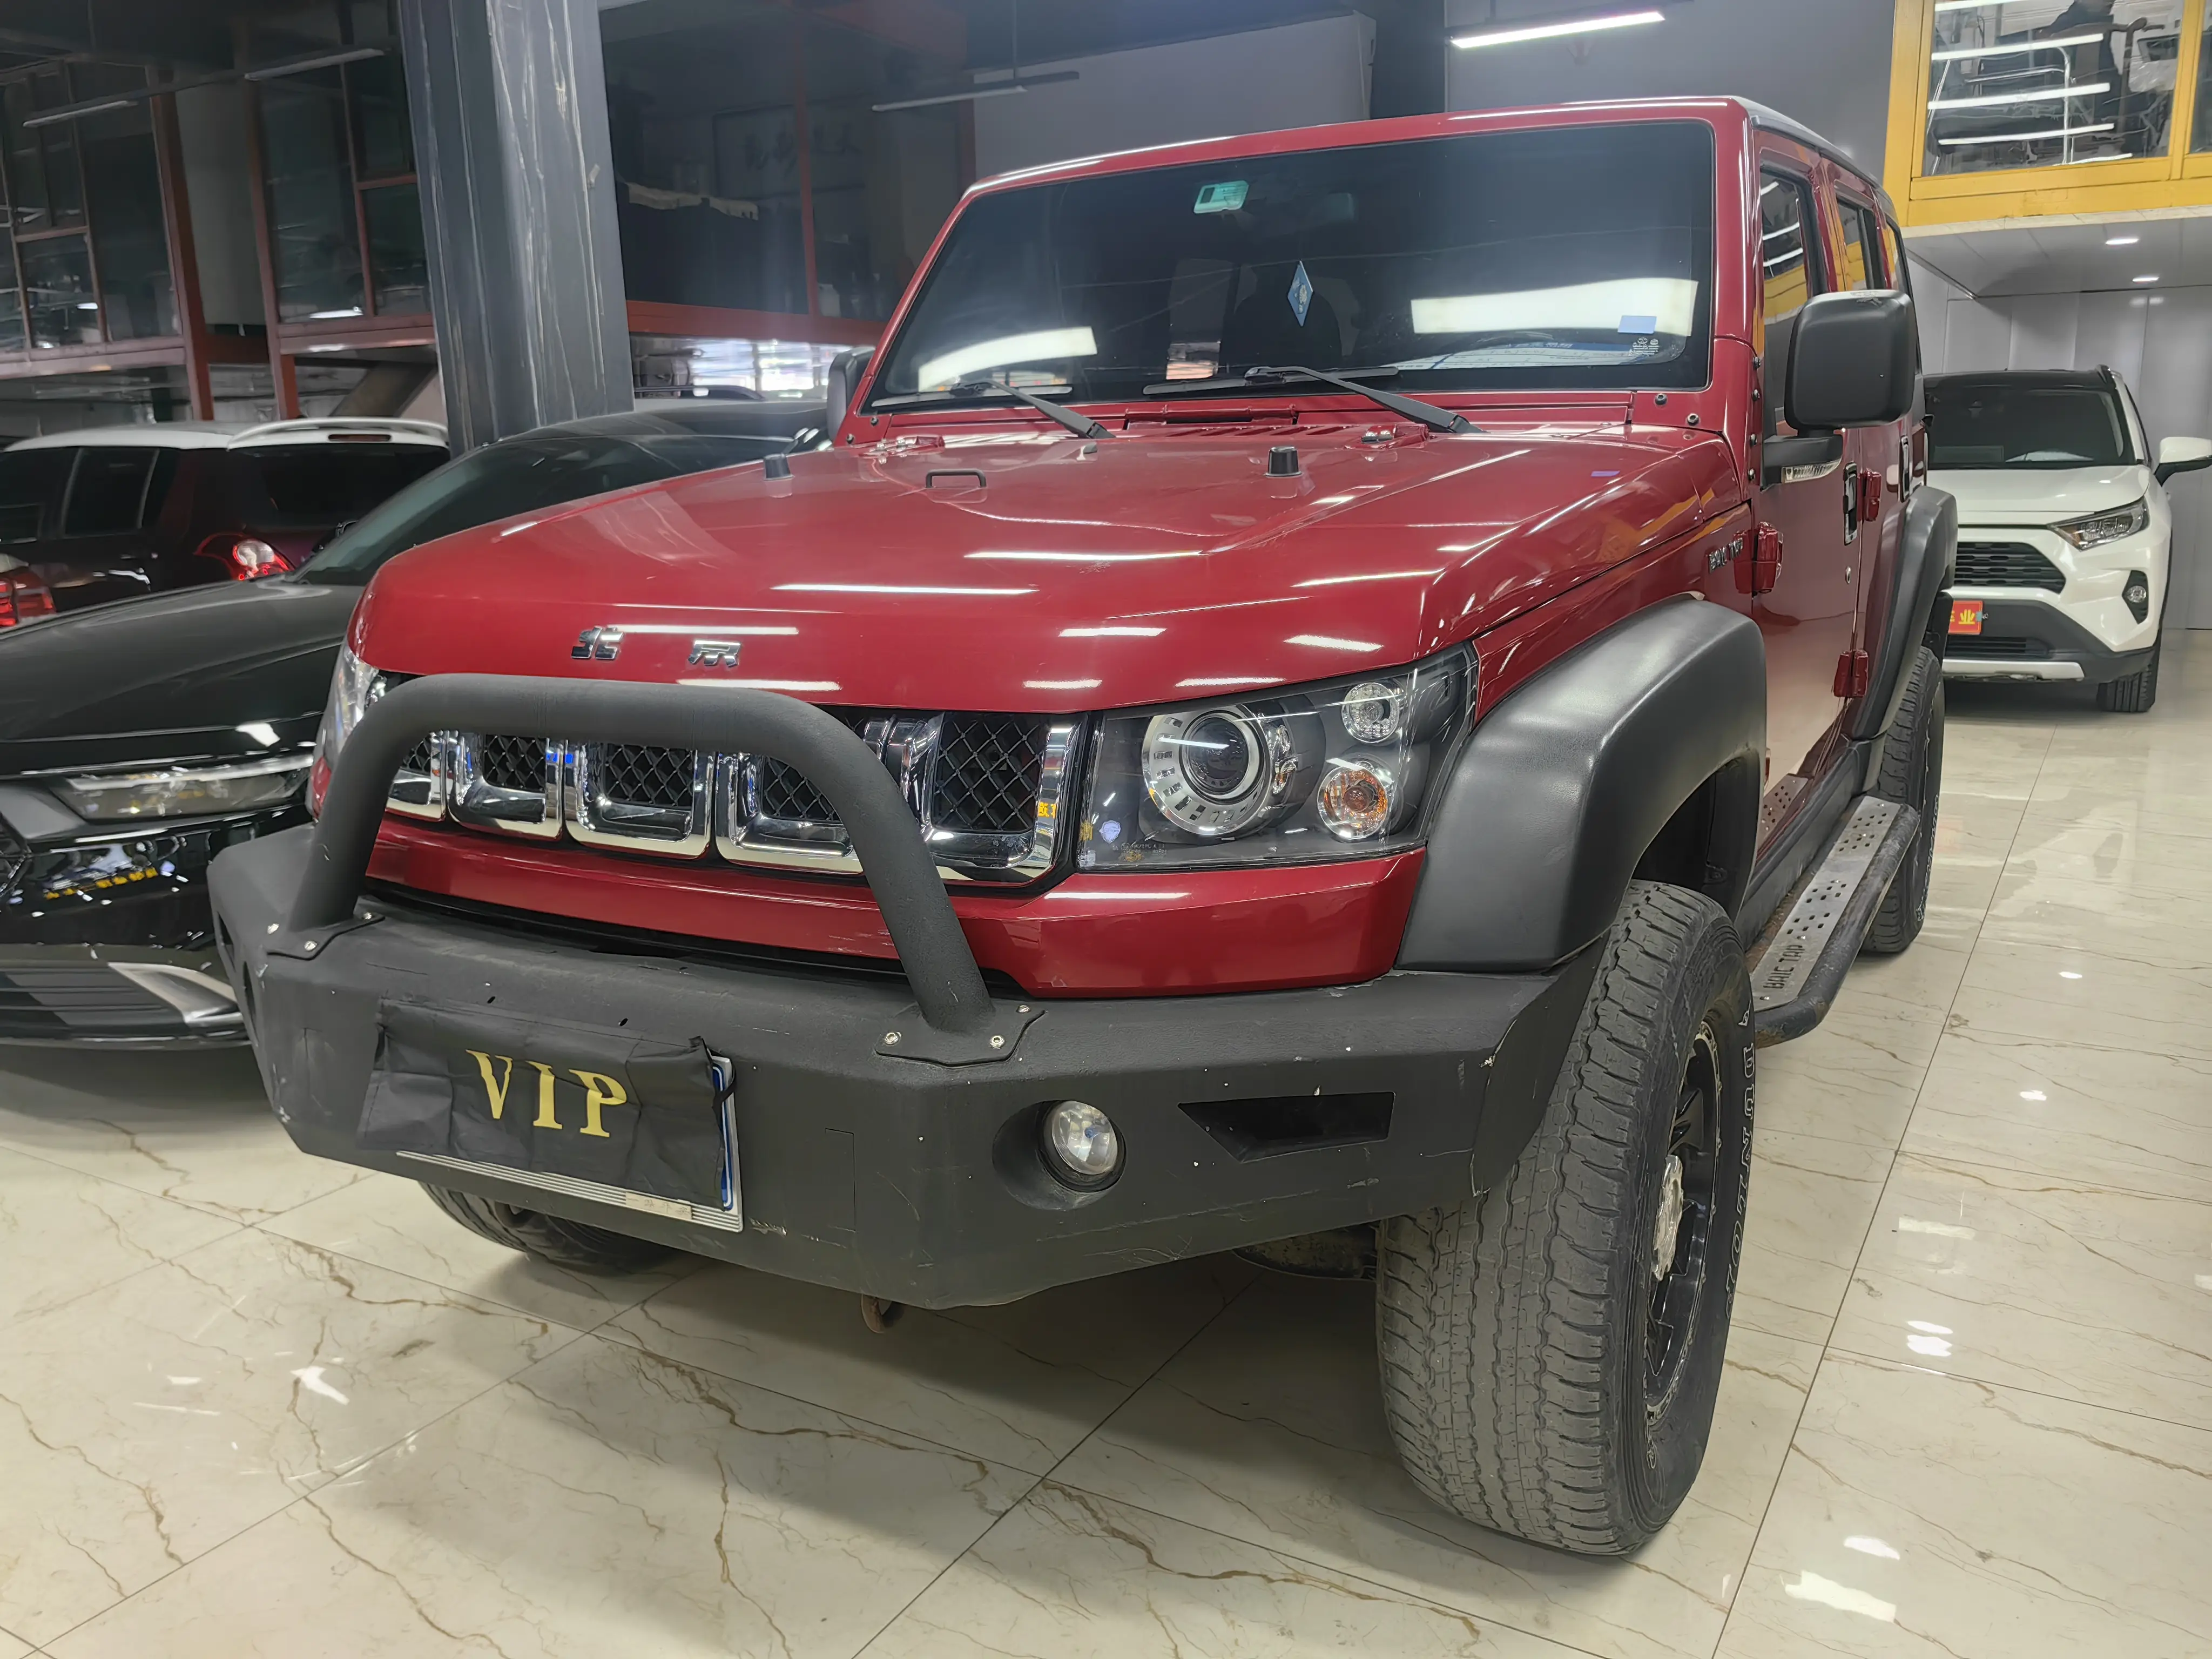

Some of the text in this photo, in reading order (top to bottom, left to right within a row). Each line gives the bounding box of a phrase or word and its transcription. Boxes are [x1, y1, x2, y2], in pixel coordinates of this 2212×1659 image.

[571, 625, 741, 667] 北京
[1763, 966, 1795, 988] BAIC
[465, 1049, 626, 1137] VIP
[1726, 1042, 1755, 1319] DUNLOP
